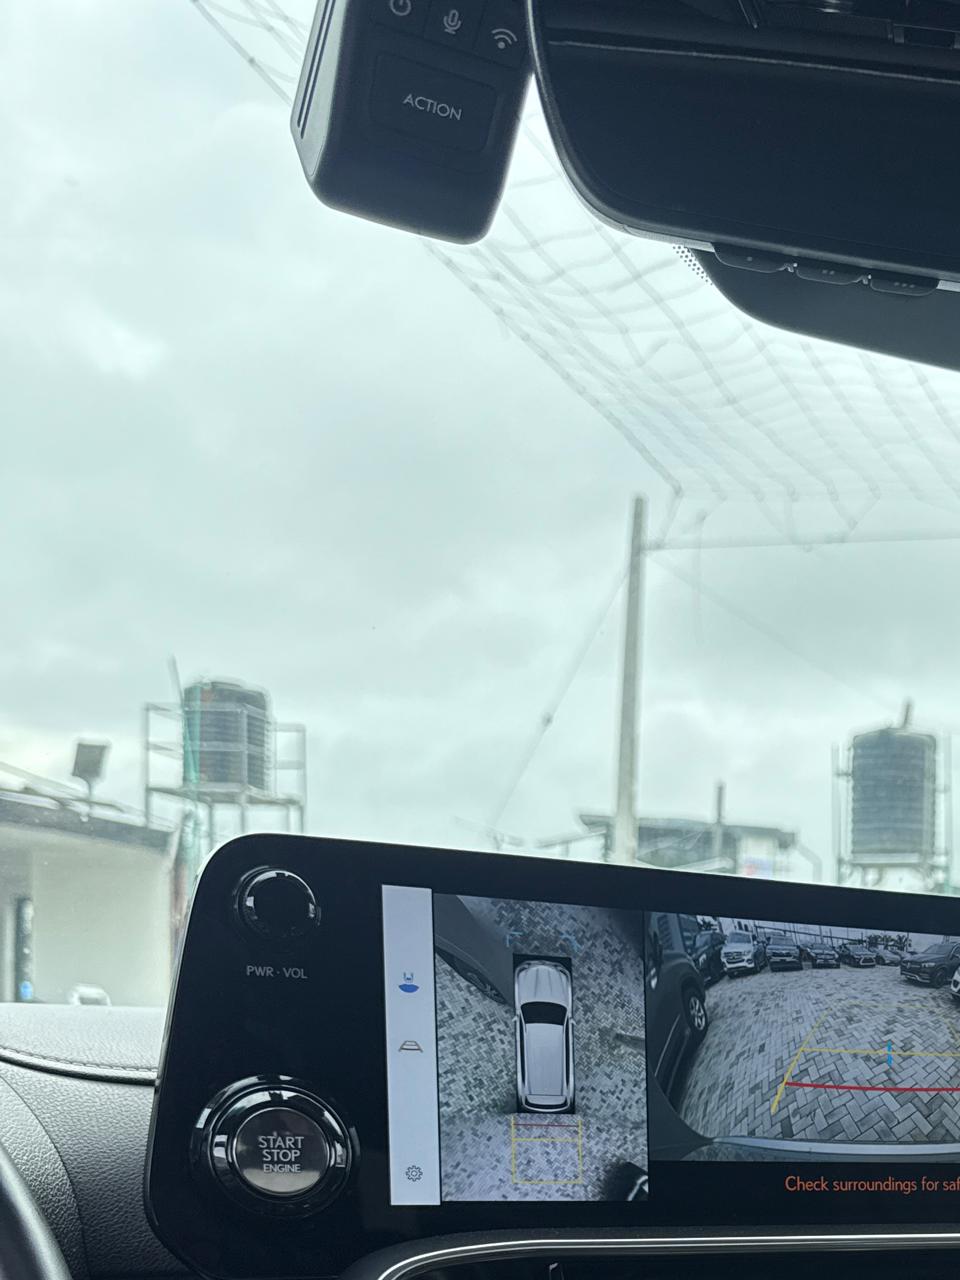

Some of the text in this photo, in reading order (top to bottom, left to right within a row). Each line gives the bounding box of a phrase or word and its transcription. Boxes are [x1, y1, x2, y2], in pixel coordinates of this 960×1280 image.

[402, 93, 462, 121] ACTION
[246, 965, 309, 979] PWR VOL
[258, 1135, 305, 1149] START
[262, 1149, 301, 1162] STOP
[263, 1163, 302, 1173] ENGINE
[784, 1175, 830, 1192] Check
[832, 1176, 918, 1195] surroundings
[921, 1176, 940, 1191] for
